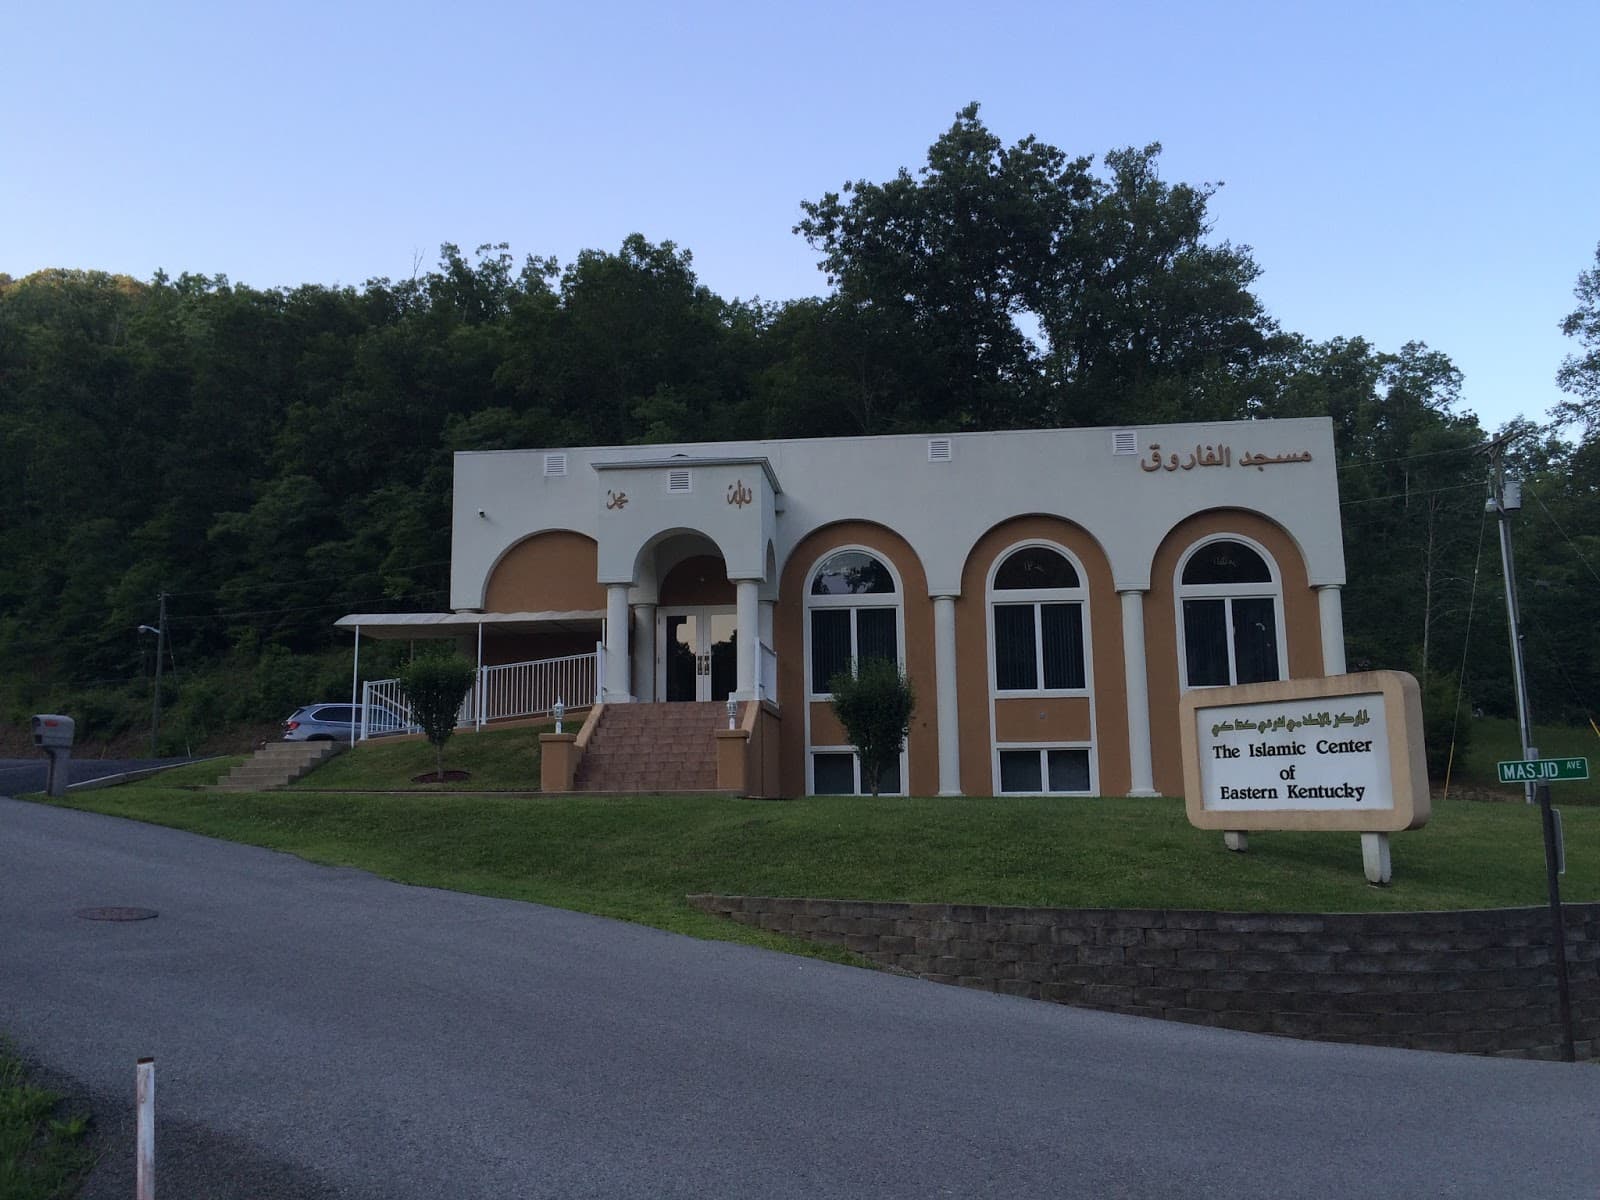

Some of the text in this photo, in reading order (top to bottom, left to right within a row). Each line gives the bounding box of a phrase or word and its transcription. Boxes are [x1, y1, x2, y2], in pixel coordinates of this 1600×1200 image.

[1140, 443, 1312, 472] مسجد الفاروق
[1213, 740, 1373, 759] The Islamic Center
[1279, 765, 1296, 780] of
[1503, 760, 1582, 779] MASJID AVE
[1220, 783, 1366, 801] Eastern Kentucky
